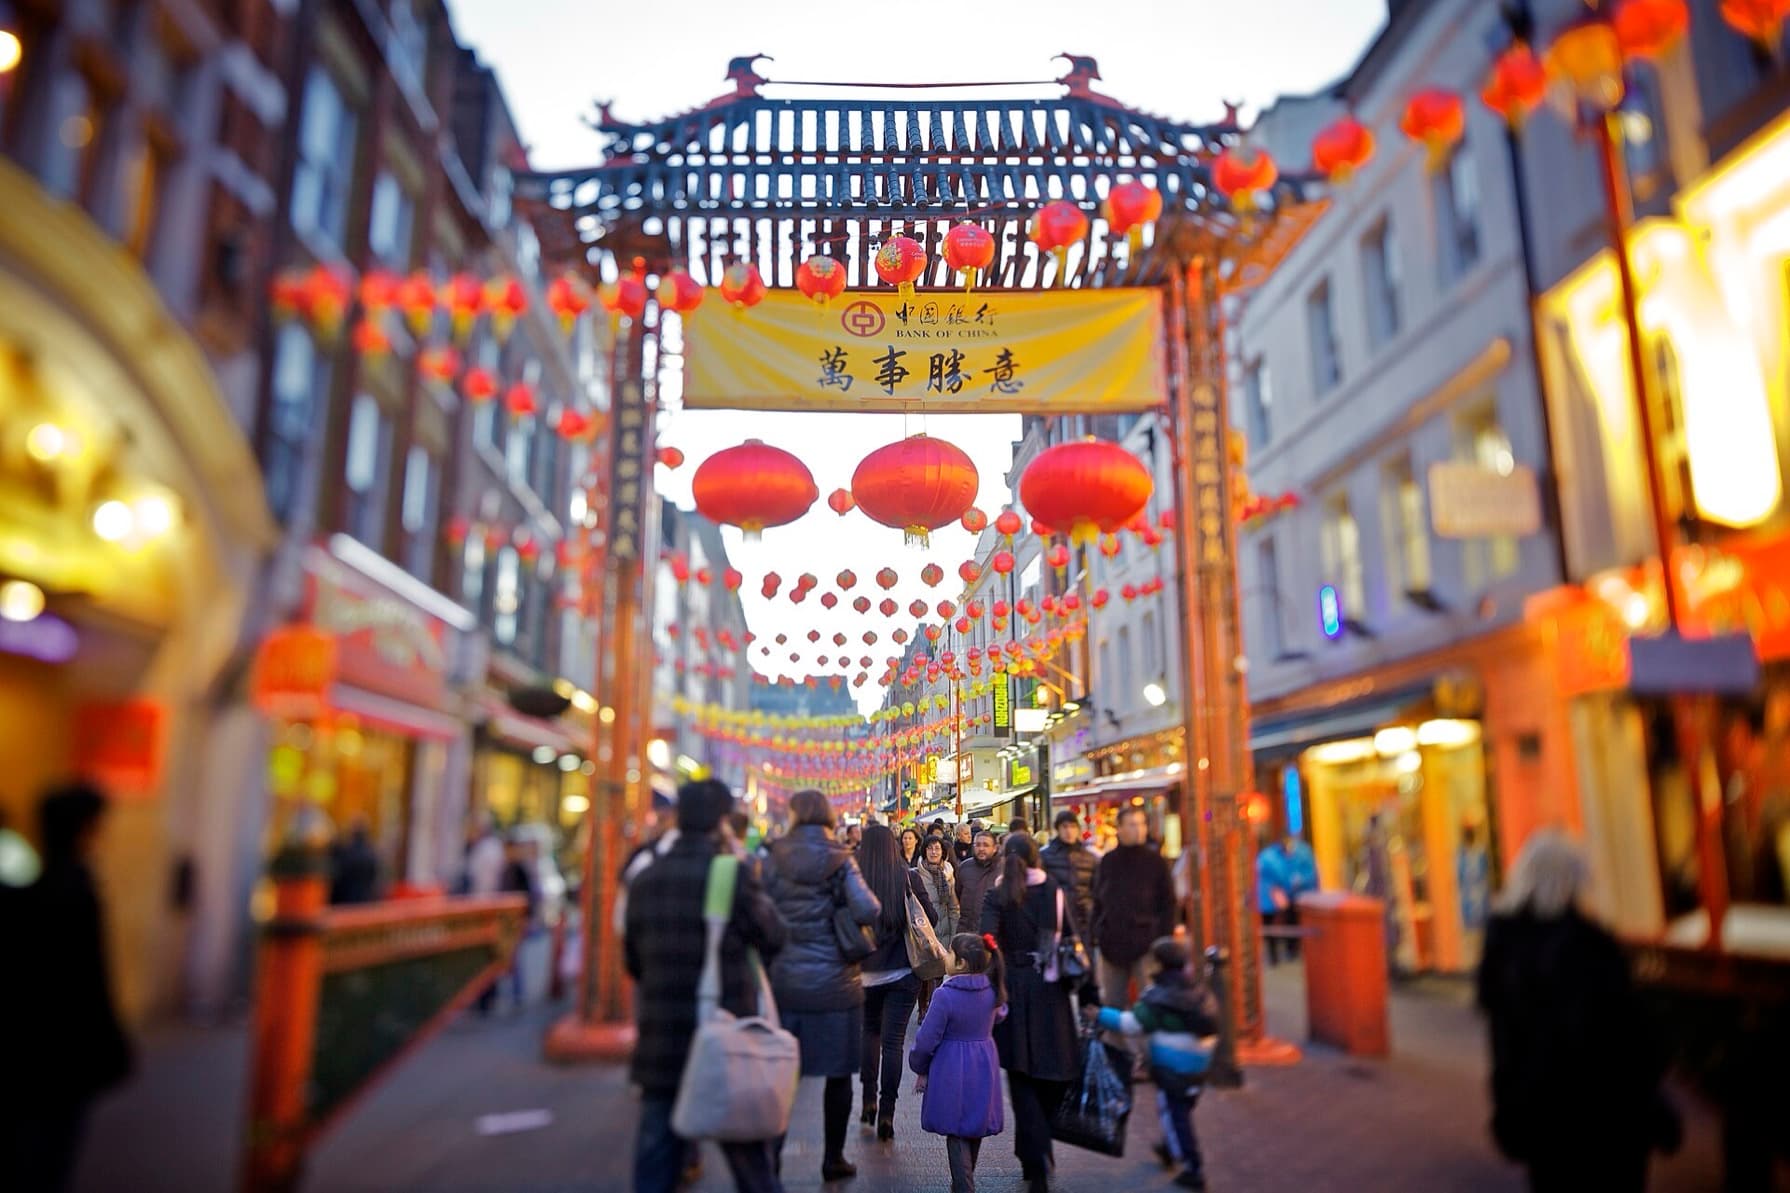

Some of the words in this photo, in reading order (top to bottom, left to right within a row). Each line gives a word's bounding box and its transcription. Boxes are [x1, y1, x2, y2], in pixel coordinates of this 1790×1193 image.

[895, 301, 998, 326] 中國銀行
[896, 329, 930, 338] BANK
[936, 329, 952, 338] OF
[958, 329, 998, 338] CHINA
[817, 344, 1024, 395] 萬事勝意
